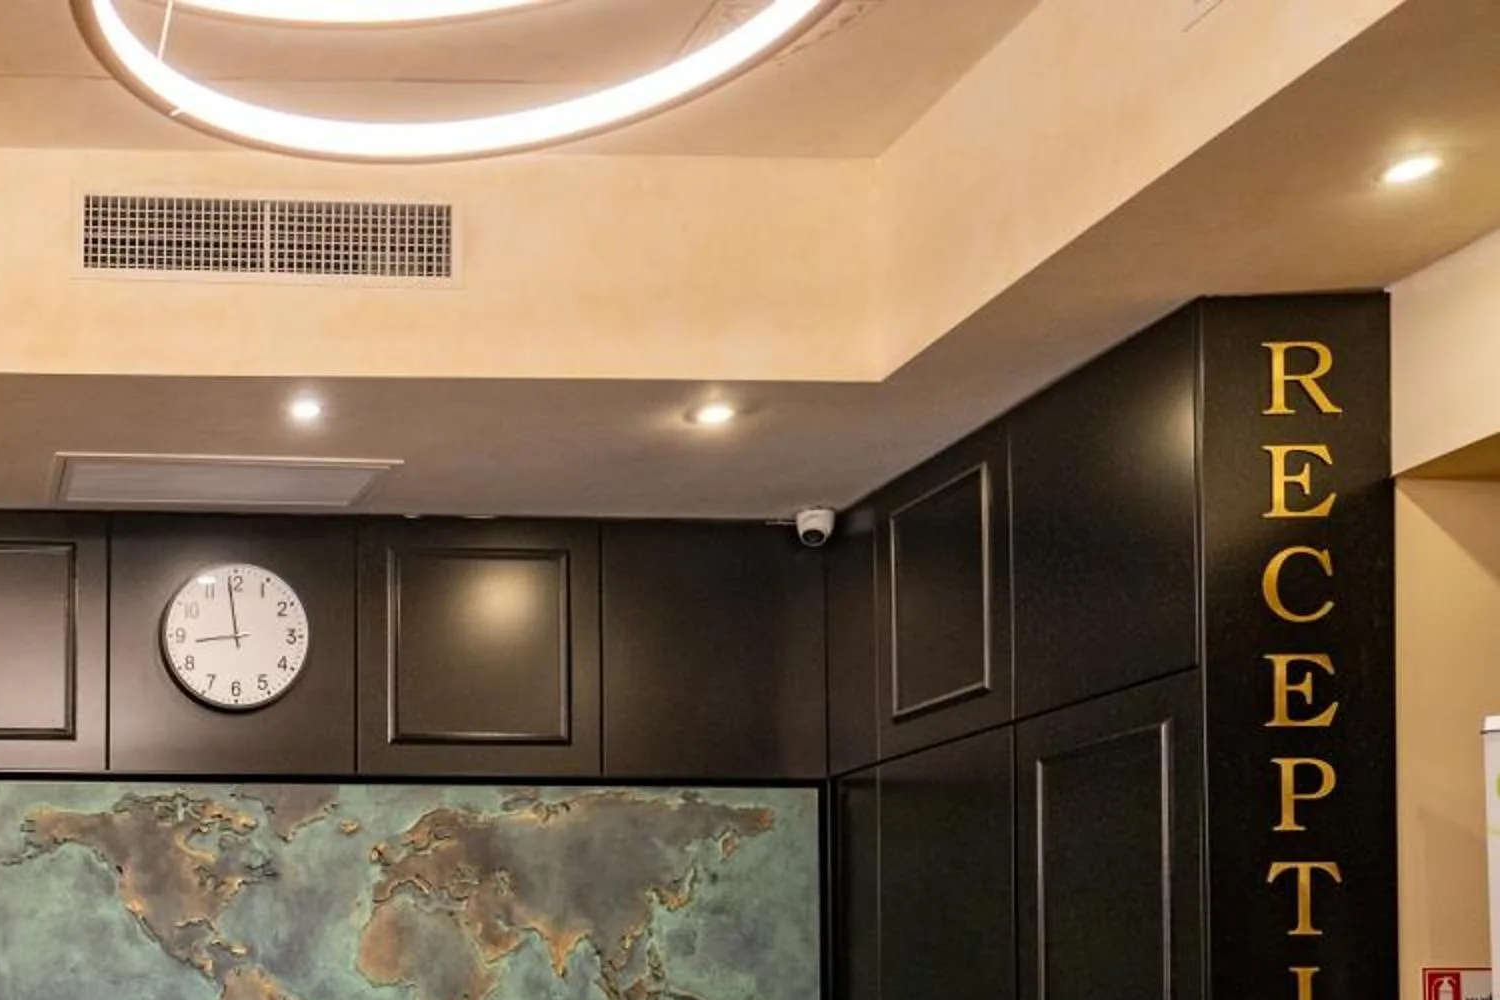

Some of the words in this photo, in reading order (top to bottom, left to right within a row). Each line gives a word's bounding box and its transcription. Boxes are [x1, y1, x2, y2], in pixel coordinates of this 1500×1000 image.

[184, 601, 200, 620] 10
[277, 601, 287, 617] 2
[175, 627, 186, 644] 9
[286, 629, 297, 645] 3
[184, 656, 195, 671] 8
[277, 656, 288, 671] 4
[206, 674, 217, 690] 7
[231, 681, 241, 697] 6
[257, 674, 269, 690] 5
